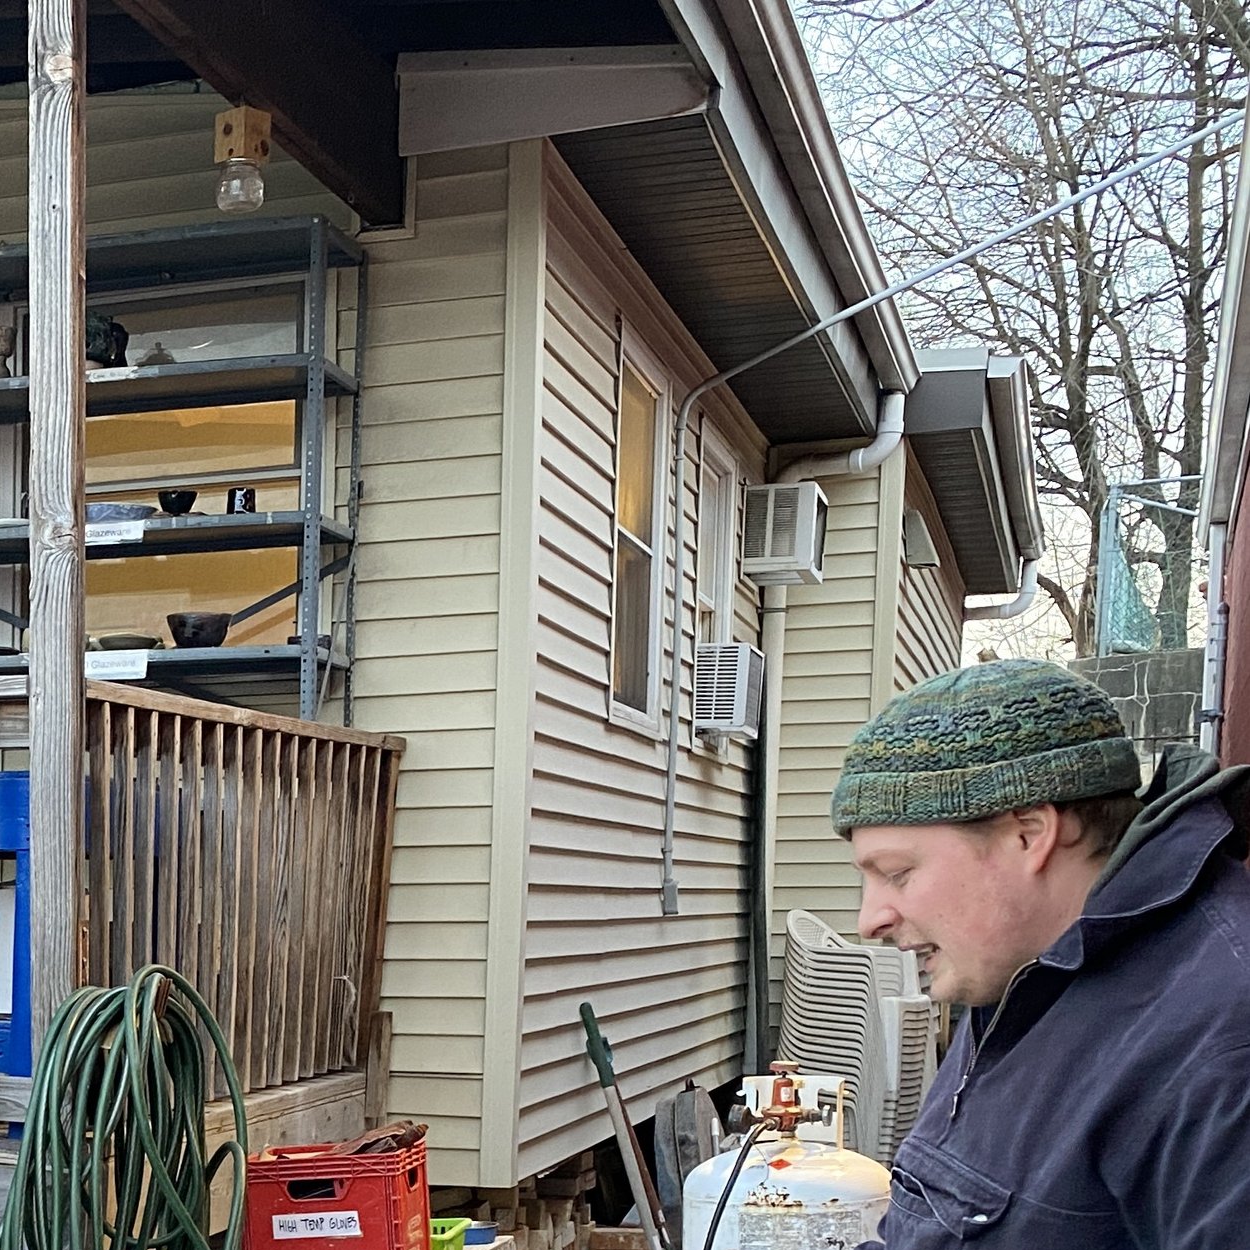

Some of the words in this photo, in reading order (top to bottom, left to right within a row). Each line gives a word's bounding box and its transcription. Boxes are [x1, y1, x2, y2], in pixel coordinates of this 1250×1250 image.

[278, 1220, 298, 1233] HIGH
[300, 1217, 325, 1231] TEMP
[329, 1216, 358, 1230] GLOVES
